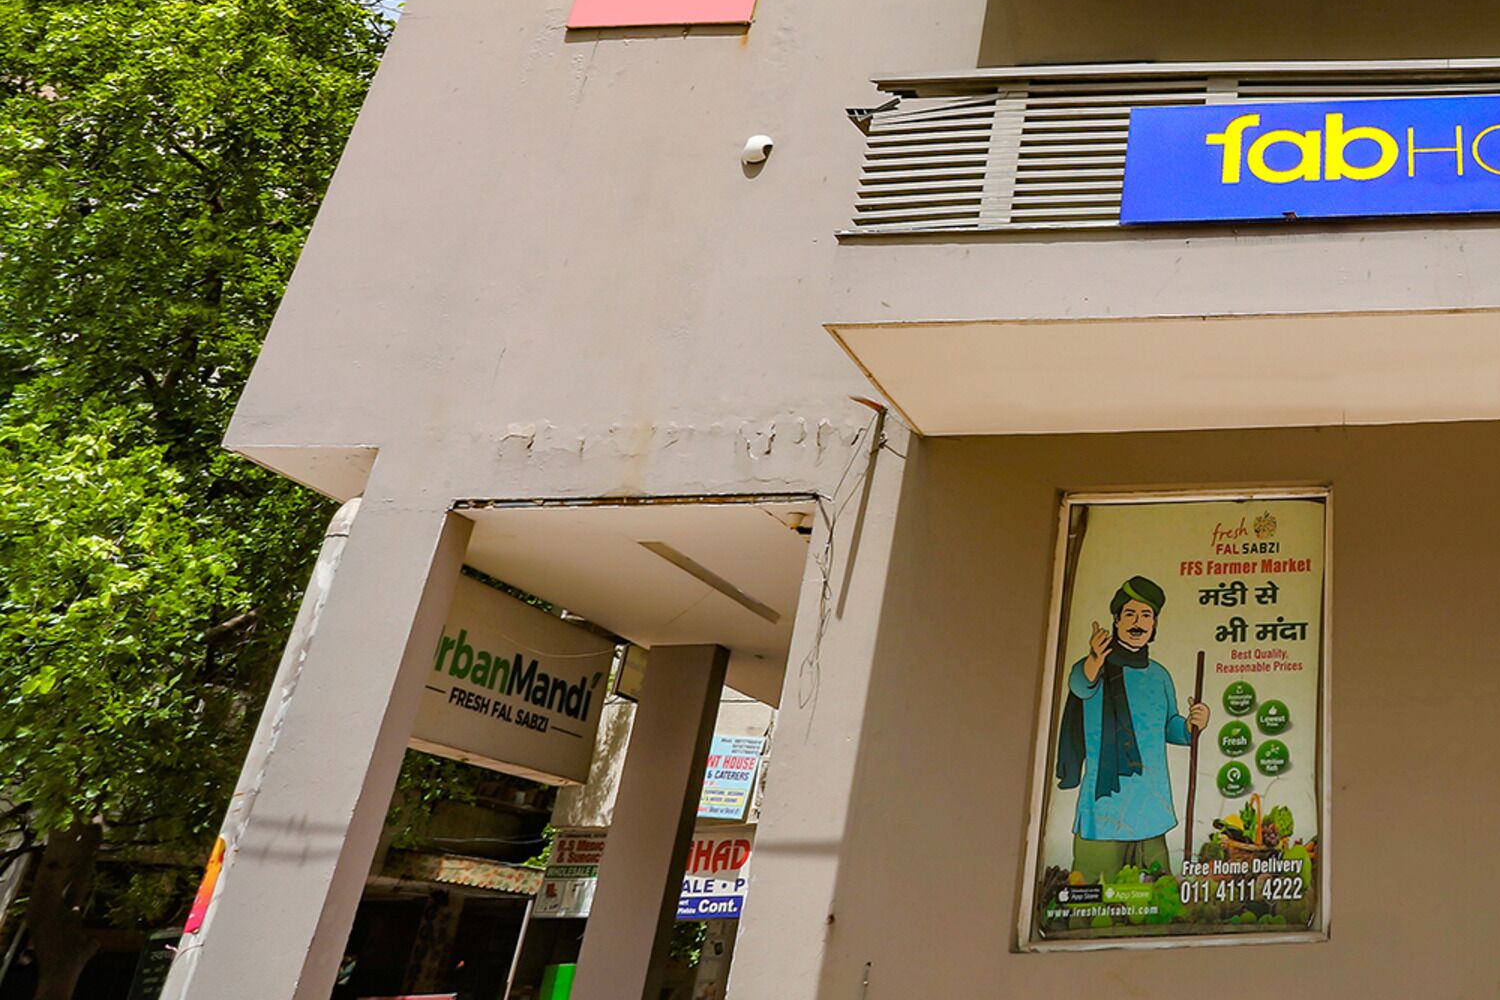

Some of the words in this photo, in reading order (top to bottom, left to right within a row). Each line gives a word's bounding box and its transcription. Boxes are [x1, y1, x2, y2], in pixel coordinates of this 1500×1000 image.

[1210, 517, 1249, 547] fresh
[1216, 543, 1239, 555] FAL
[1242, 541, 1280, 554] SABZI
[1180, 560, 1203, 576] FFS
[1206, 559, 1258, 576] Farmer
[1261, 558, 1312, 574] Market
[1198, 581, 1249, 608] मंडी
[1254, 581, 1280, 605] से
[1214, 616, 1249, 643] भी
[1255, 616, 1309, 642] मंदा
[1230, 649, 1251, 660] Best
[432, 624, 604, 722] rbanMandi
[1215, 662, 1271, 674] Reasonable
[1273, 660, 1304, 672] Prices
[448, 686, 491, 716] FRESH
[490, 700, 513, 723] FAL
[514, 708, 550, 734] SABZI
[1222, 735, 1248, 746] Fresh
[722, 755, 756, 771] HOUSE
[1181, 859, 1210, 876] Free
[1212, 858, 1249, 876] Home
[1251, 857, 1304, 876] Delivery
[1180, 880, 1210, 905] 011
[1215, 878, 1257, 903] 4111
[1261, 877, 1304, 900] 4222
